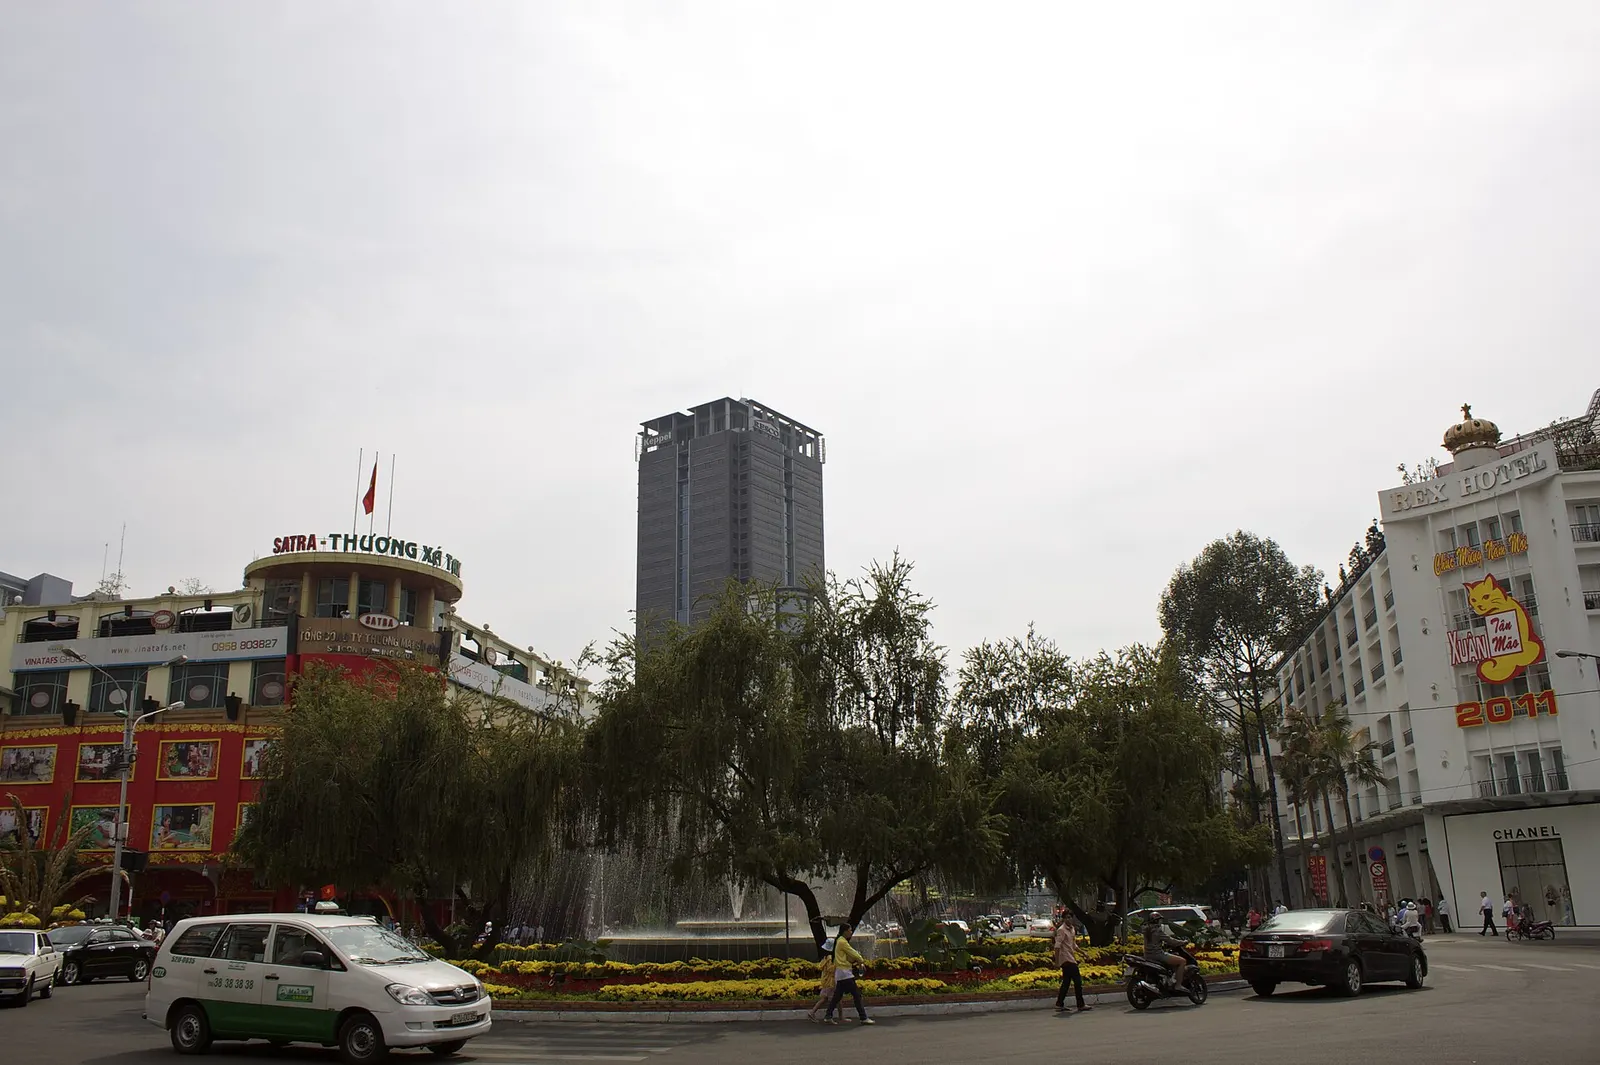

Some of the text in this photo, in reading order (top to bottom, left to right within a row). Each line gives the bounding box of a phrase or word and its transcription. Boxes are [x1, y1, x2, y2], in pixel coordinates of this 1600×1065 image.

[643, 431, 672, 446] Keppel
[1390, 451, 1547, 513] REX HOTEL
[273, 533, 317, 554] SATRA
[329, 533, 417, 560] THƯƠNG
[365, 615, 394, 628] SATRA
[1490, 617, 1513, 633] Tân
[212, 638, 278, 652] 0958 803827
[1447, 629, 1491, 666] XUÂN
[1492, 635, 1519, 652] Mão
[25, 656, 58, 666] VINATAFS
[1455, 689, 1558, 728] 2011
[1493, 825, 1561, 840] CHANEL
[224, 978, 234, 989] 38
[234, 979, 244, 989] 38
[245, 979, 254, 990] 38
